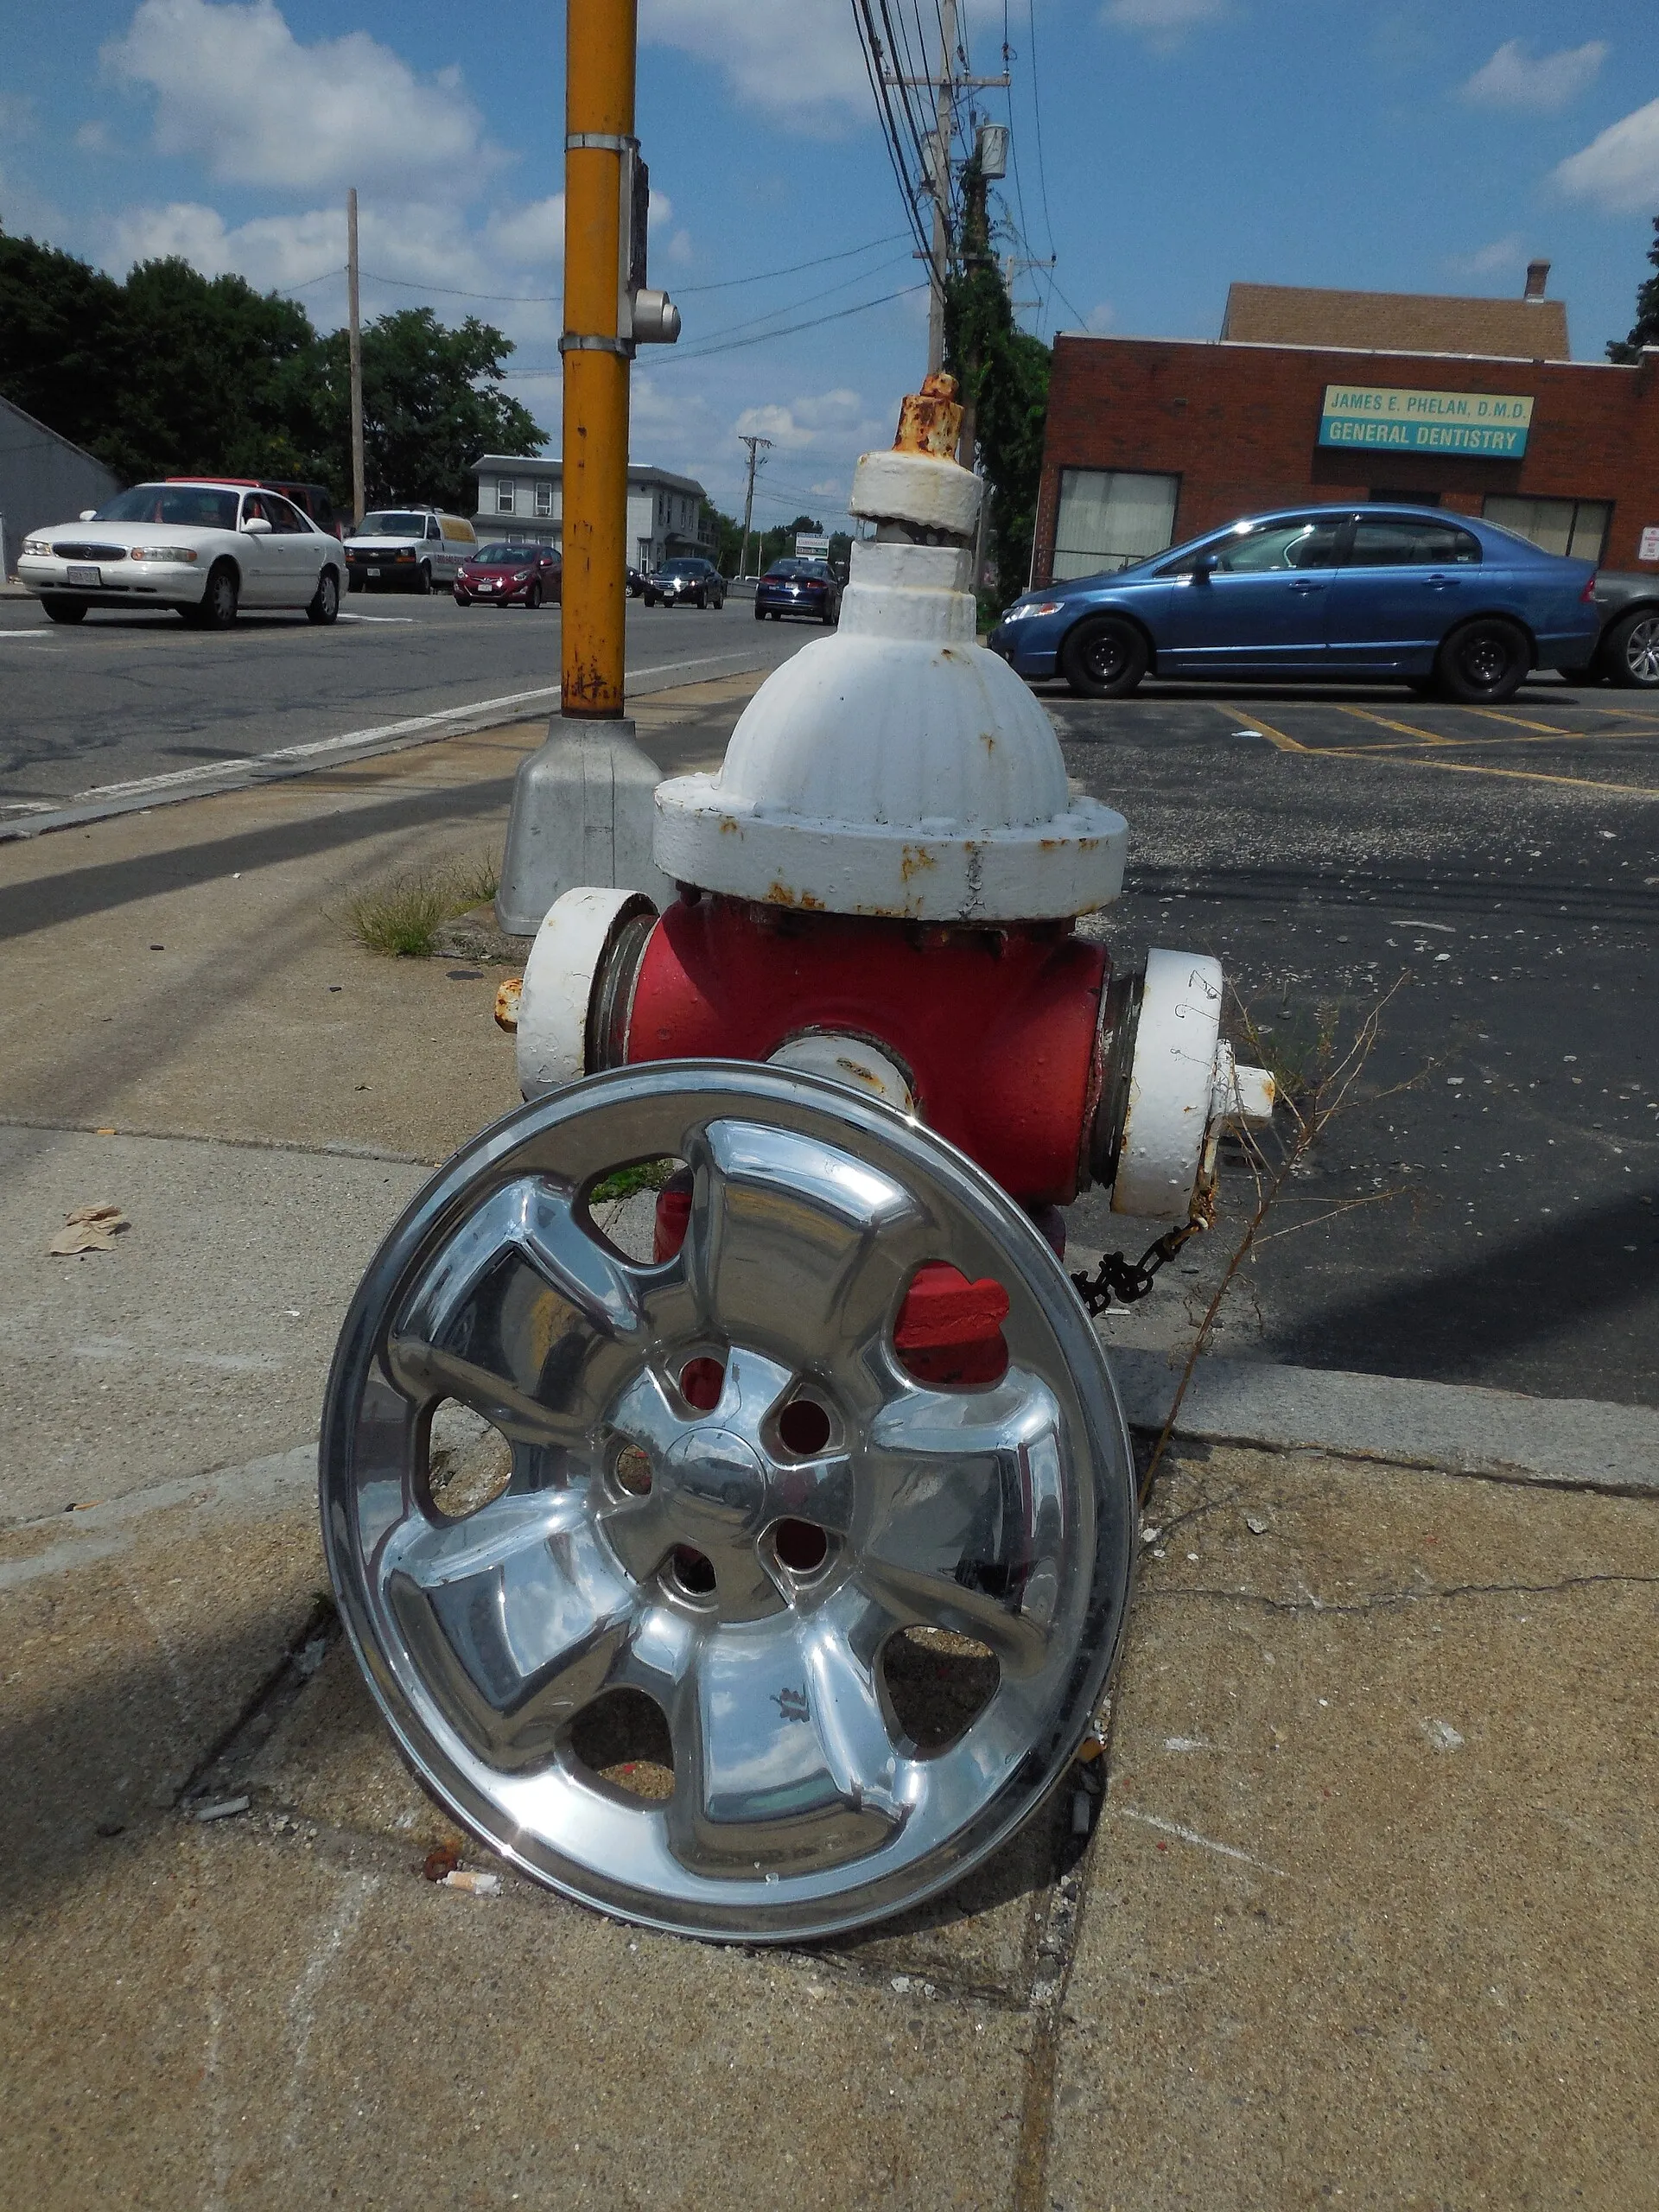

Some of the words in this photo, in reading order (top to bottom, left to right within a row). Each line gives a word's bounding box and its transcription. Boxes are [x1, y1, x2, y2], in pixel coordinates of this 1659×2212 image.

[1331, 392, 1381, 410] JAMES
[1388, 397, 1400, 412] E.
[1407, 397, 1471, 417] PHELAN,
[1477, 401, 1527, 419] D.M.D.
[1329, 422, 1409, 443] GENERAL
[1416, 426, 1517, 450] DENTISTRY
